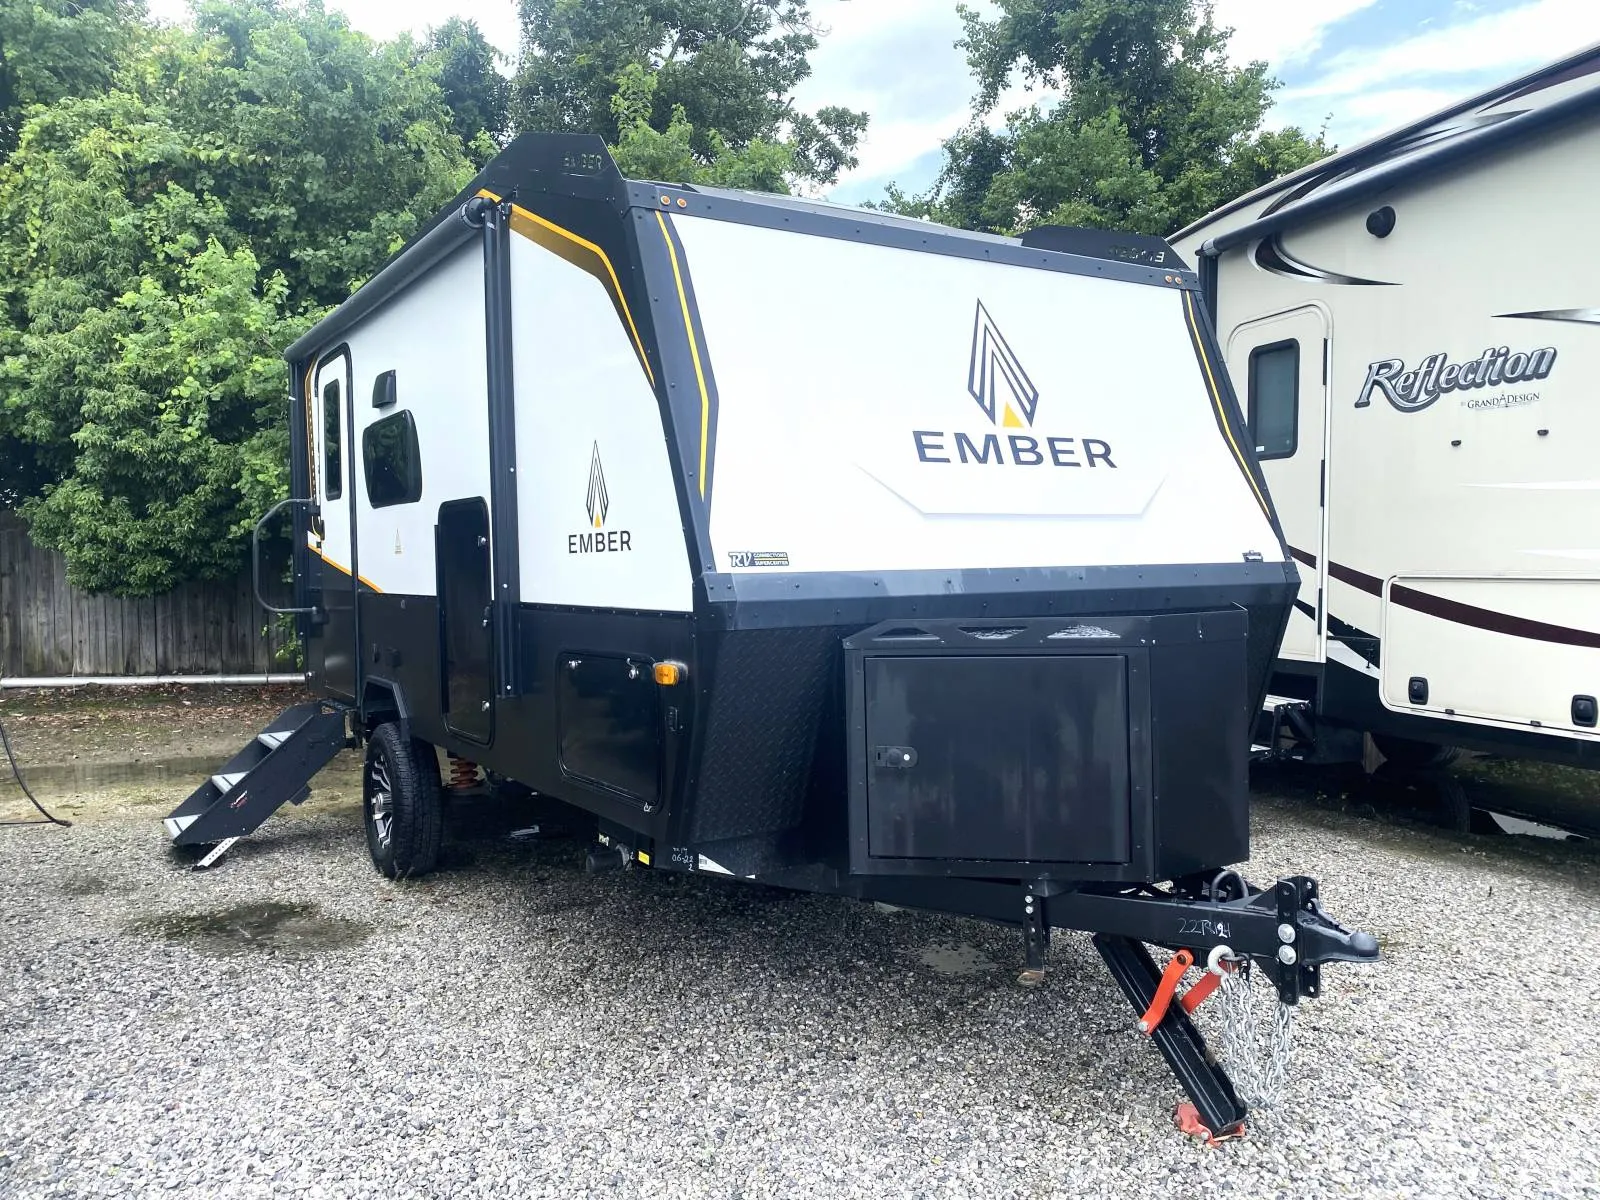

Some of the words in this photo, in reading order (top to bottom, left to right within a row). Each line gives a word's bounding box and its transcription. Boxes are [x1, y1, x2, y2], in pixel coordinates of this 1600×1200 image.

[1354, 346, 1558, 413] Reflection
[1467, 397, 1499, 409] GRAND
[1507, 392, 1540, 404] DESIGN
[912, 431, 1118, 468] EMBER
[568, 530, 632, 554] EMBER
[728, 551, 751, 567] RV
